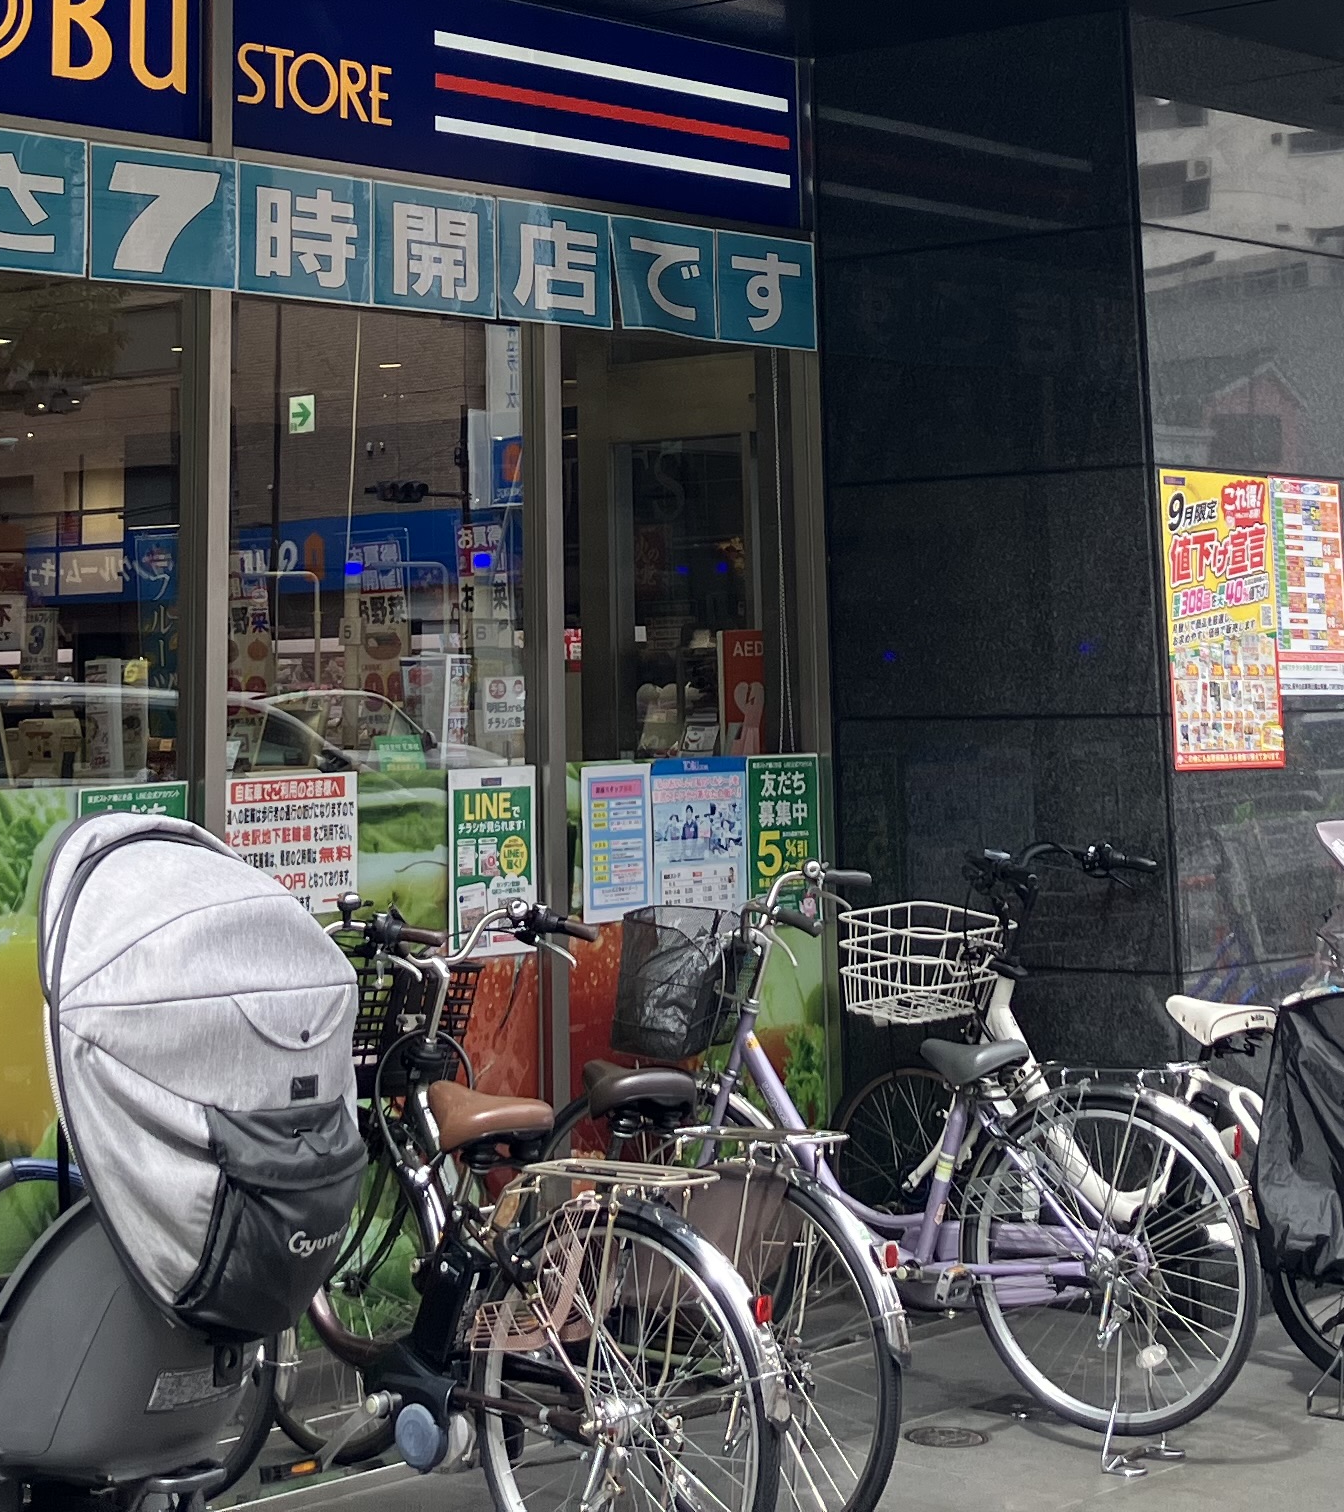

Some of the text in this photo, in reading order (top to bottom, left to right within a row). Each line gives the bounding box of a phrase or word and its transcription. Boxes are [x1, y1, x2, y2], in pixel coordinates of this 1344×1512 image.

[236, 43, 393, 127] STORE
[1168, 492, 1218, 531] 9月限定
[1170, 525, 1267, 586] 値下げ宣言
[732, 640, 763, 657] AED
[235, 780, 341, 802] 自転車でご利用のお客様へ
[760, 770, 807, 797] 友だち
[464, 792, 521, 821] LINEで
[759, 799, 808, 827] 募集中
[458, 820, 526, 835] チラシが見られます!
[319, 845, 353, 864] 無料
[757, 831, 783, 877] 5
